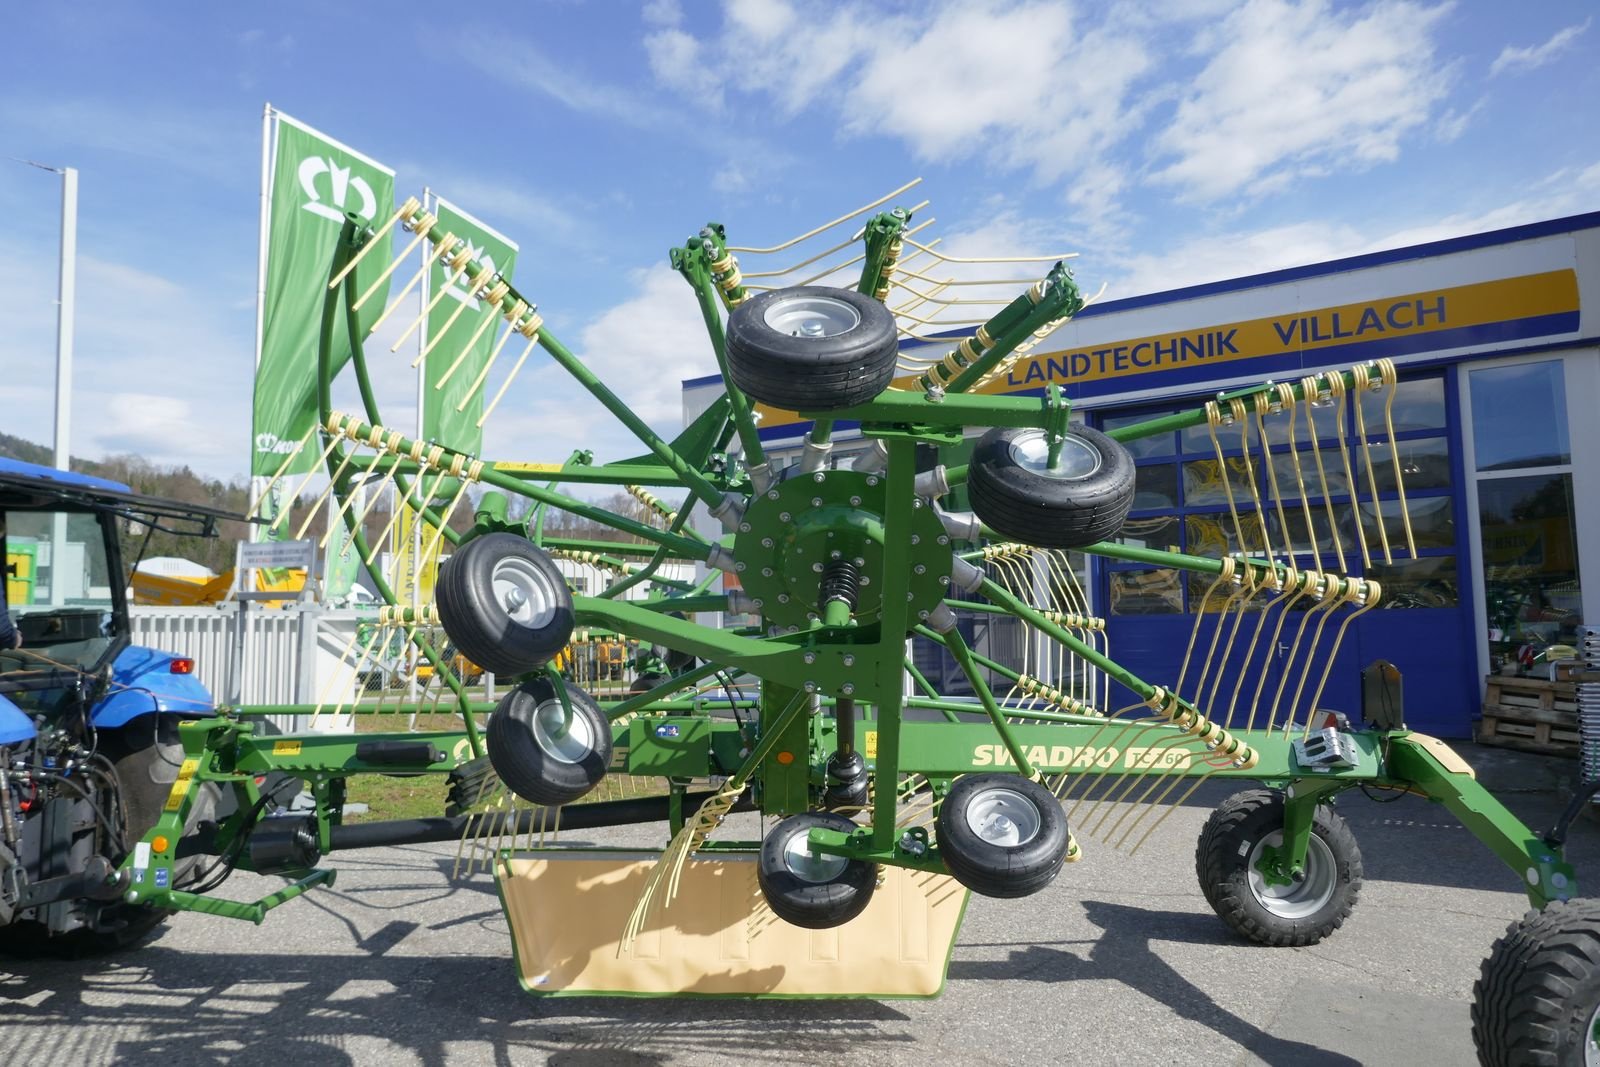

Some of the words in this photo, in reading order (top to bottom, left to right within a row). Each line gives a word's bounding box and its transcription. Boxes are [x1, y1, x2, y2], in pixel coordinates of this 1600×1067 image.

[1008, 329, 1239, 387] LANDTECHNIK
[1273, 296, 1447, 347] VILLACH
[972, 744, 1119, 768] SWADRO
